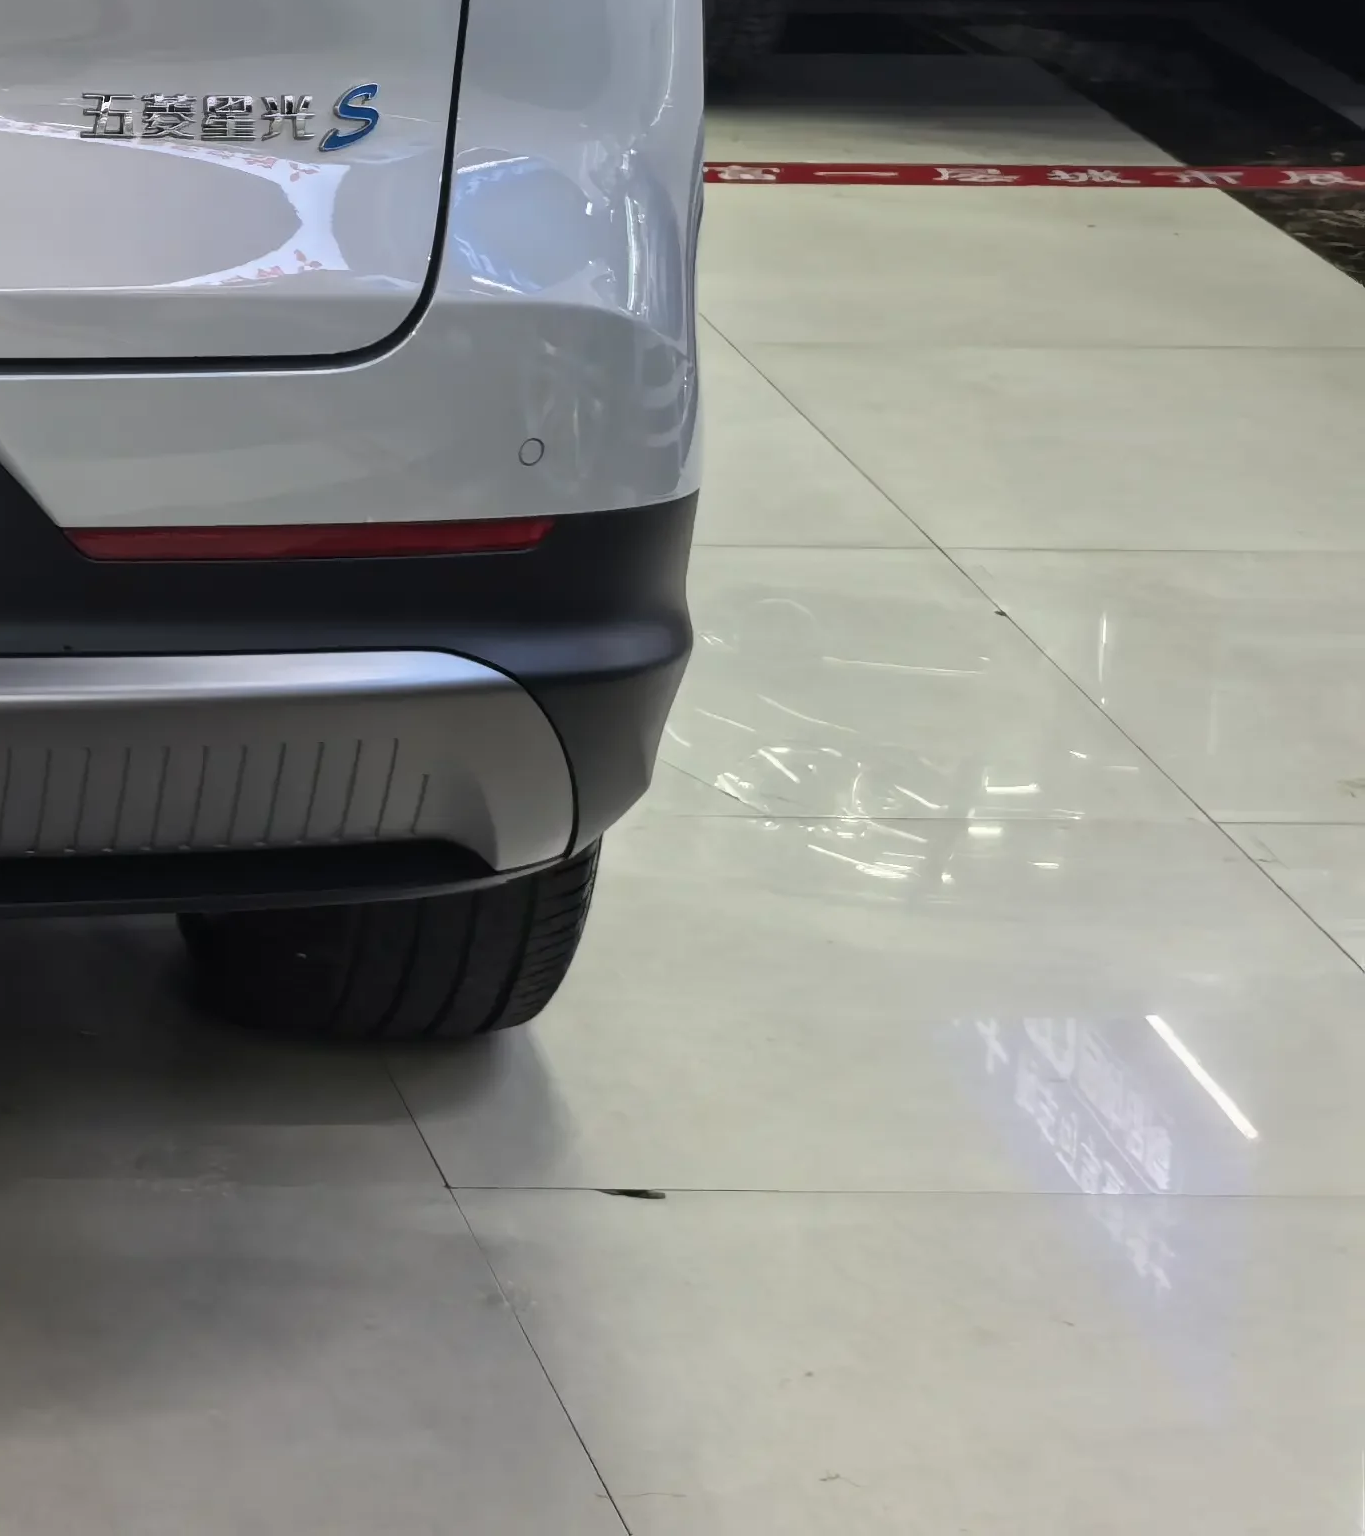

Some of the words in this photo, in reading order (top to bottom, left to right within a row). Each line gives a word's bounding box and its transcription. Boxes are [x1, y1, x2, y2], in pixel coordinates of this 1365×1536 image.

[80, 92, 316, 142] 五菱星光
[318, 82, 380, 153] S
